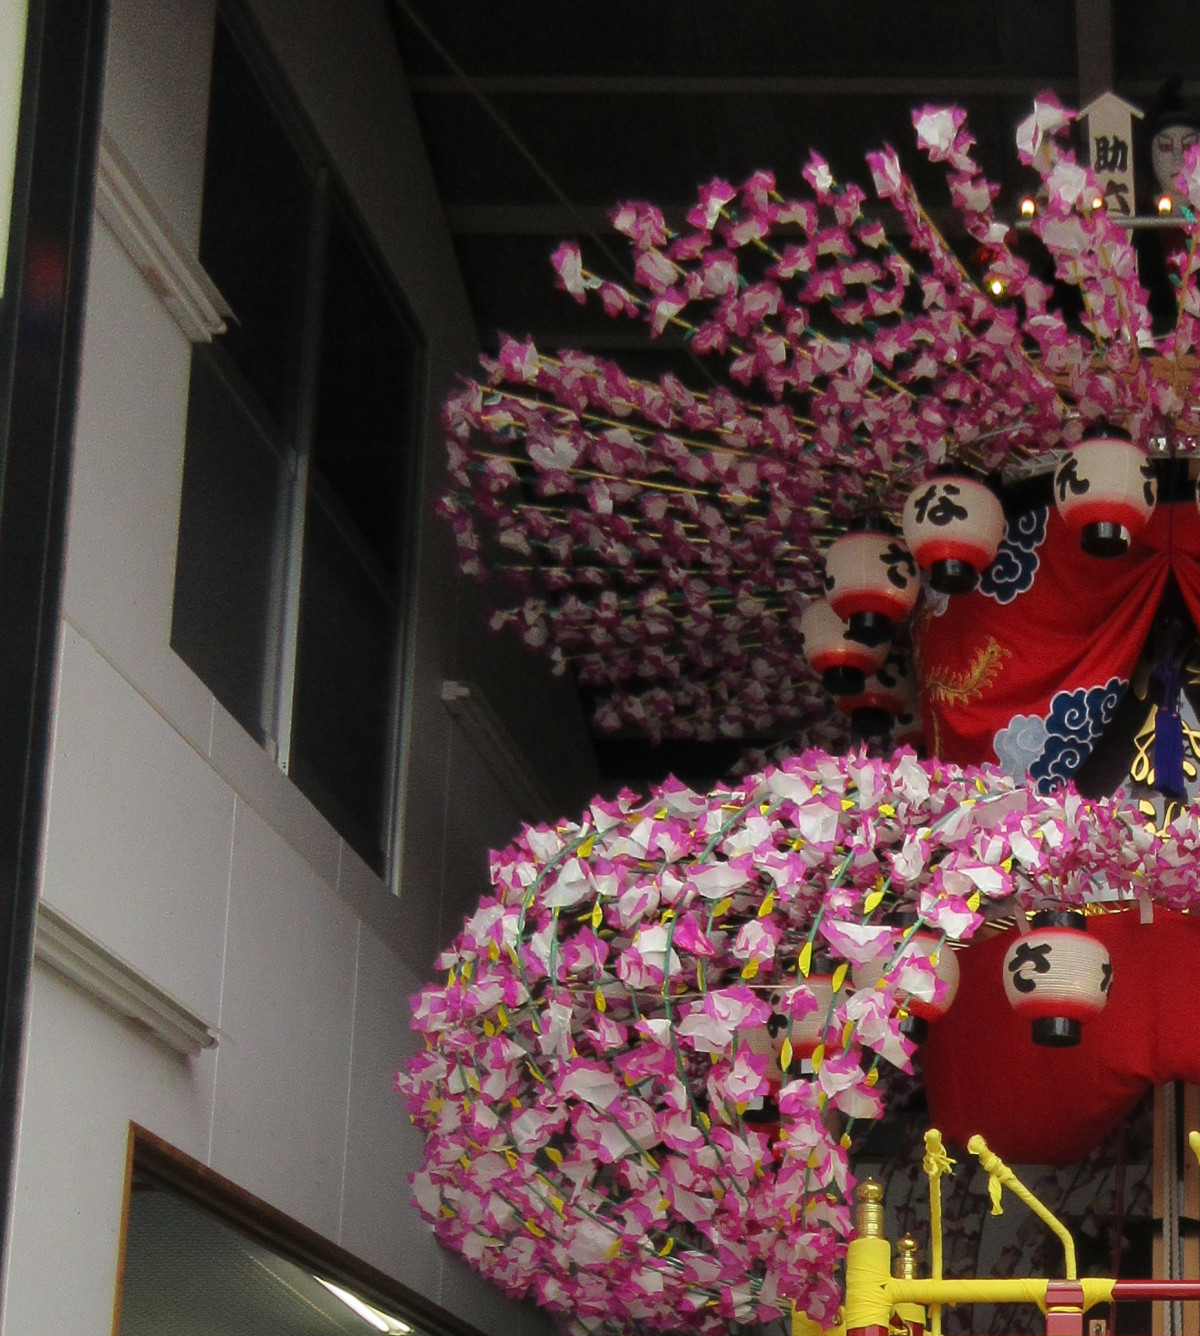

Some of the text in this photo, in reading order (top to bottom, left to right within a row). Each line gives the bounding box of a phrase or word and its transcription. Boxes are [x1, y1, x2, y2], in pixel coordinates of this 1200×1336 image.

[914, 484, 967, 526] な
[880, 543, 917, 589] さ
[1007, 942, 1052, 993] さ
